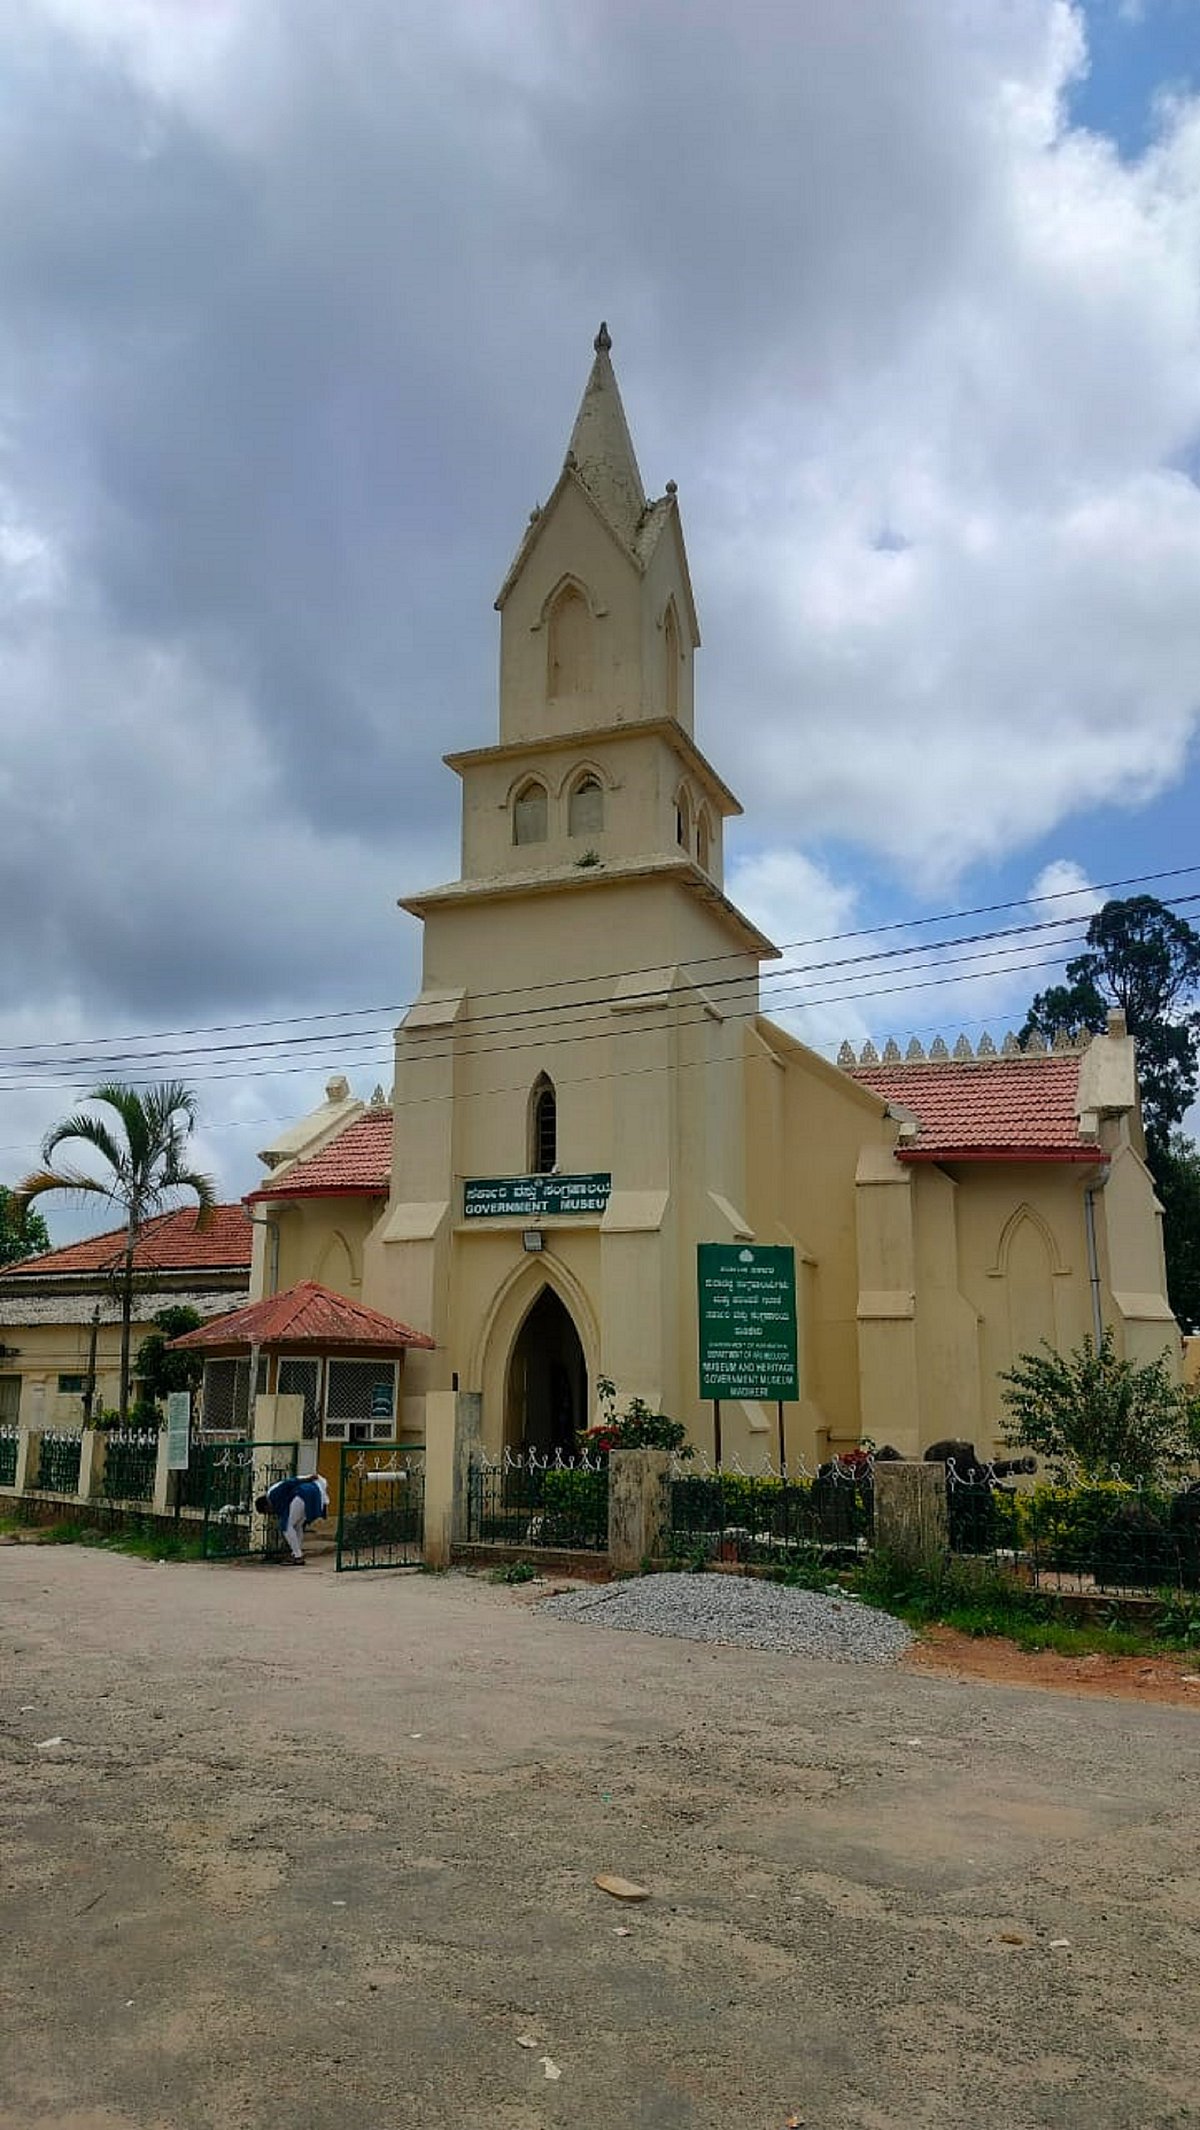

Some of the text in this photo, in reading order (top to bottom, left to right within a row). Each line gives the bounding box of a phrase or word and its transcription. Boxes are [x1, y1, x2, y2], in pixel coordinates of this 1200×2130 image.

[465, 1198, 609, 1214] GOVERNMENT MUSEU
[738, 1362, 755, 1372] AND
[704, 1374, 794, 1385] GOVERNMENT MUSEUM
